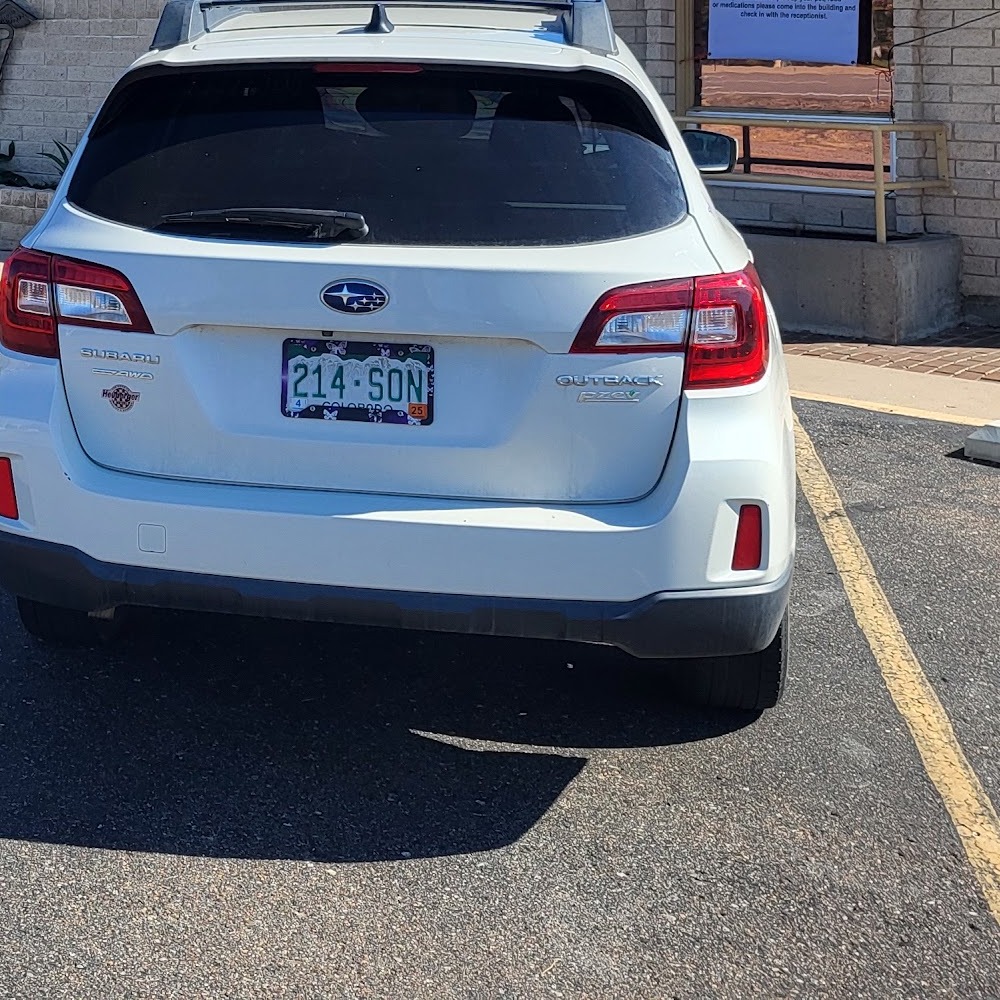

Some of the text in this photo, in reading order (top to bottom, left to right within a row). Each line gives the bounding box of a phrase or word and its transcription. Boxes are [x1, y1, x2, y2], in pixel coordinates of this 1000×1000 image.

[818, 4, 844, 12] building
[80, 347, 160, 365] SUBARU
[556, 374, 664, 387] OUTBACK
[295, 399, 301, 407] 4
[411, 406, 423, 415] 25
